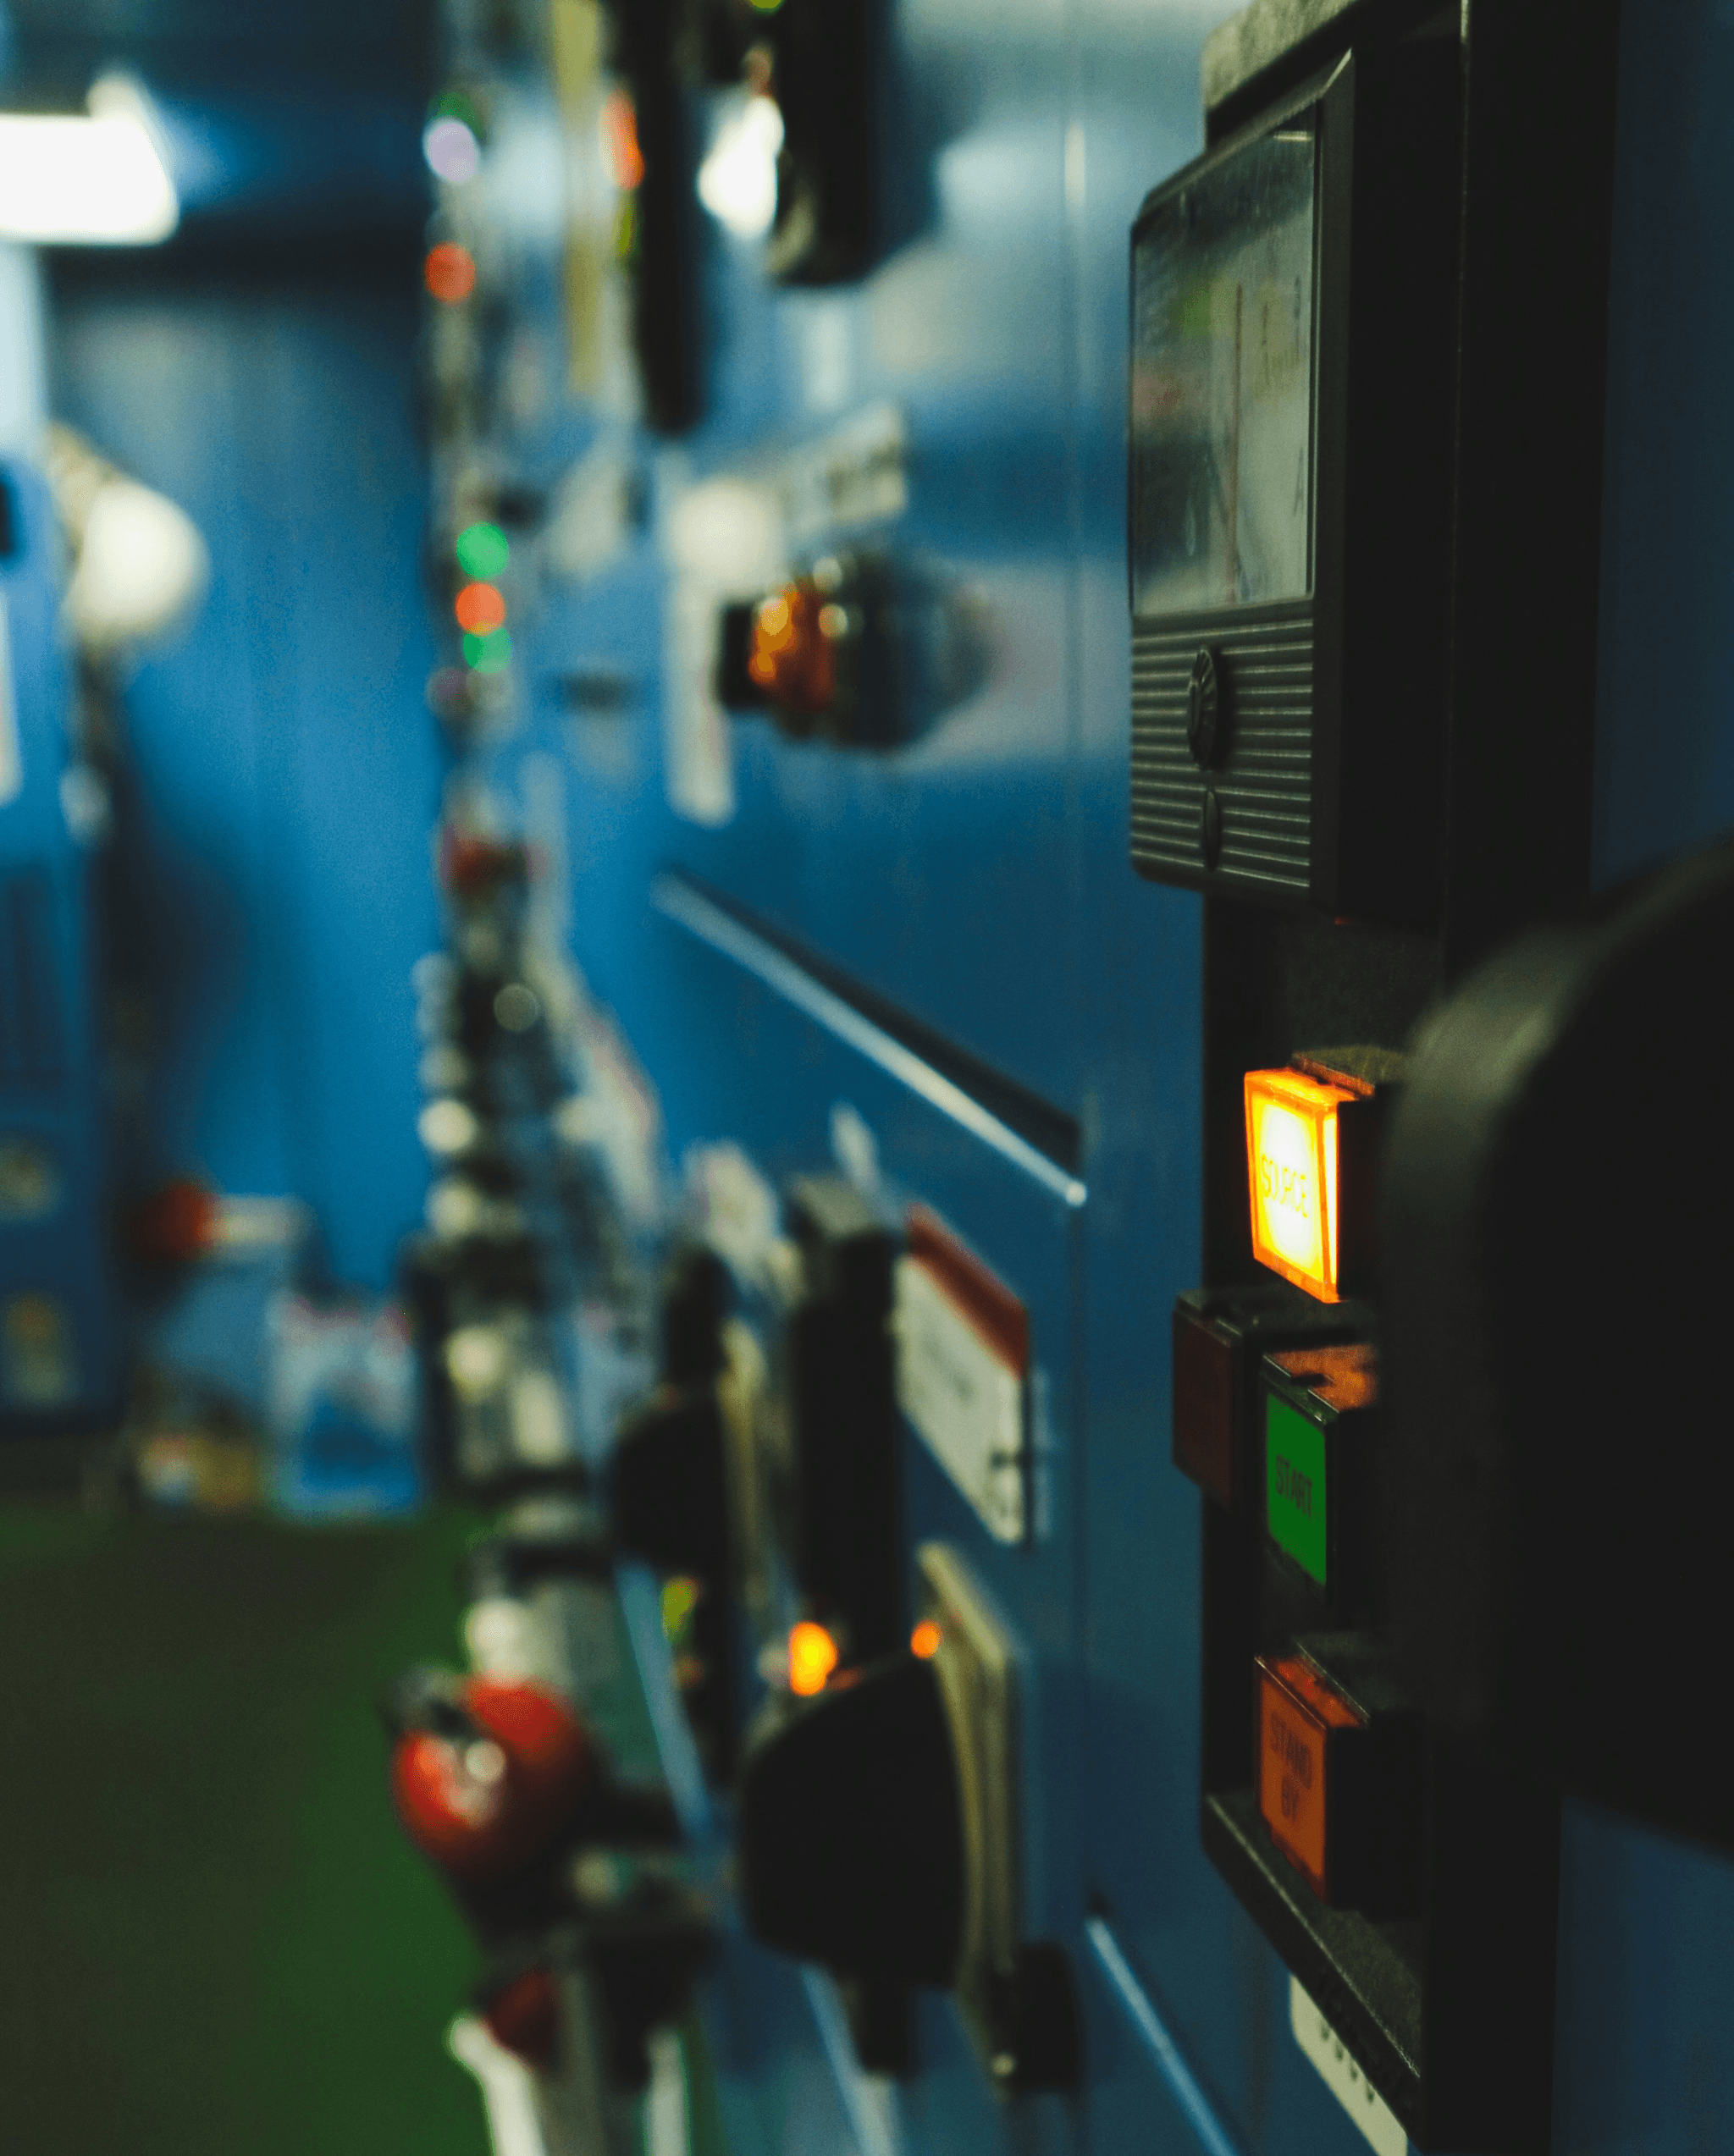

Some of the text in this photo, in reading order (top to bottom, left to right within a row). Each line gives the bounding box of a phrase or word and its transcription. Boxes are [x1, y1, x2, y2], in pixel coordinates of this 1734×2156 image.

[1261, 1154, 1309, 1219] SOURCE
[1275, 1453, 1313, 1520] START
[1271, 1712, 1313, 1790] STAND
[1281, 1776, 1300, 1822] BY
